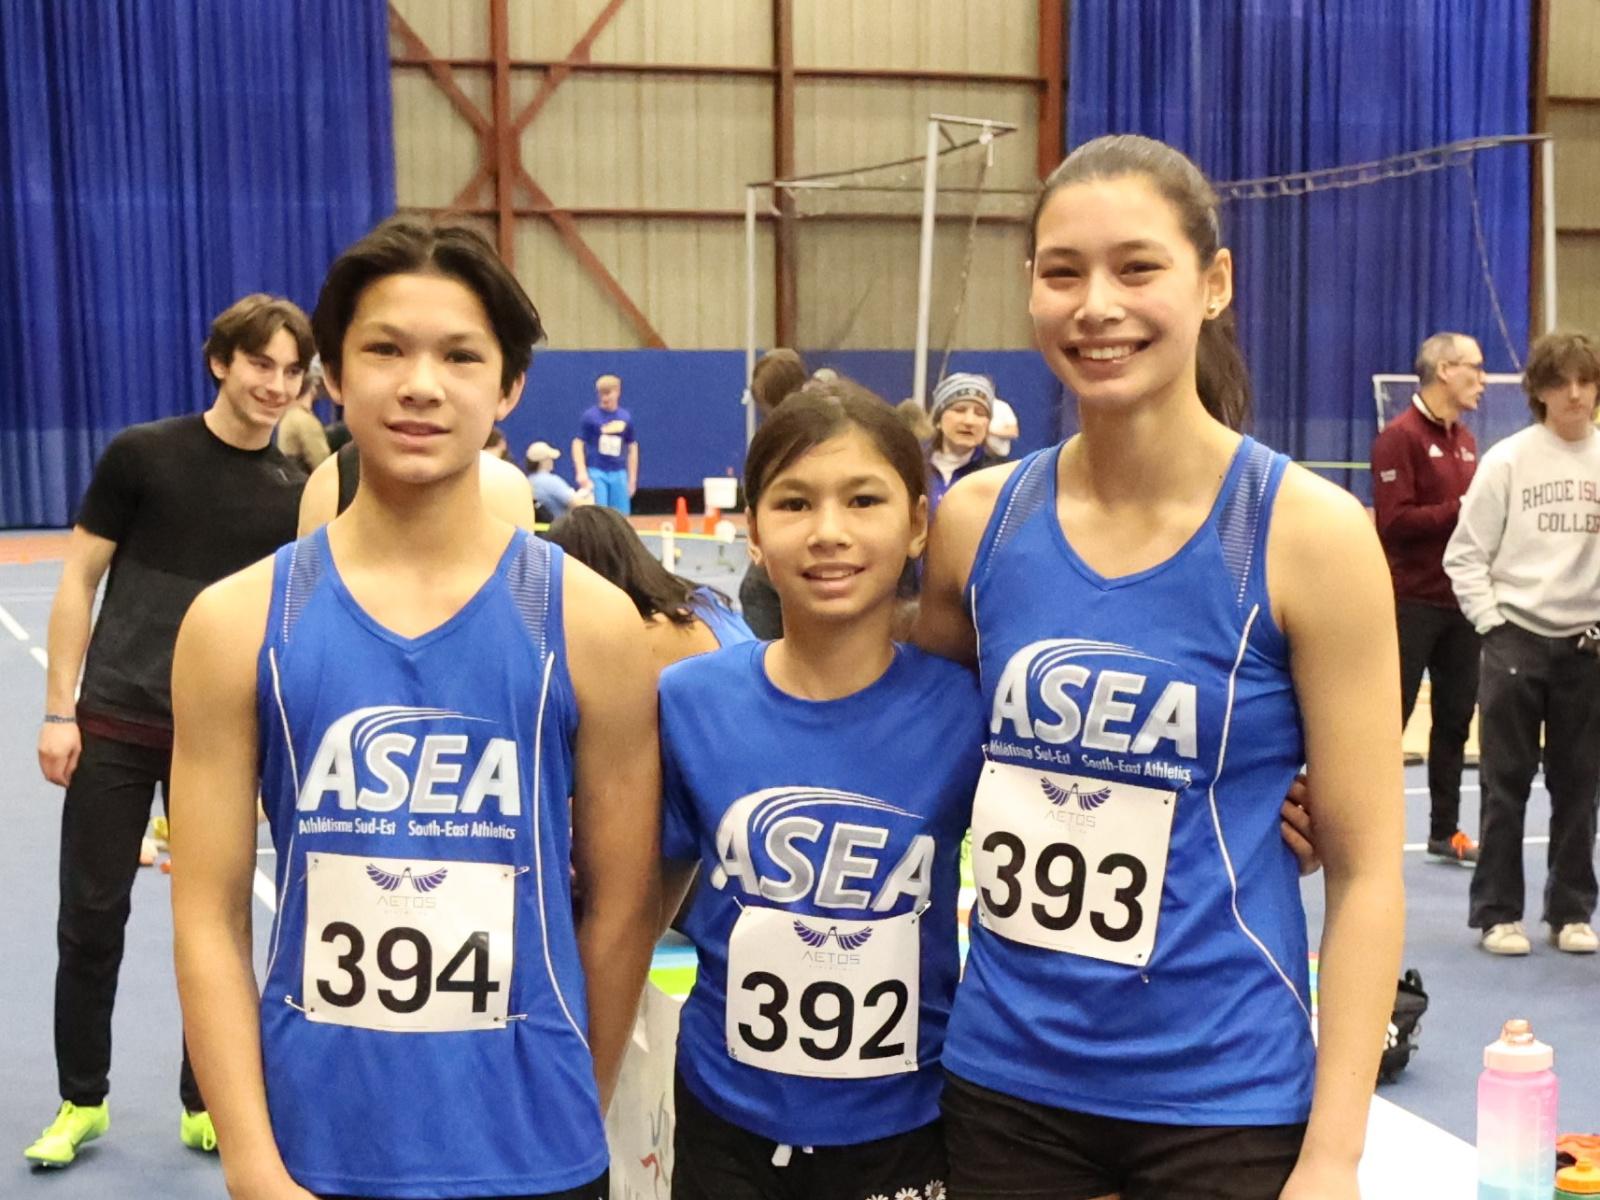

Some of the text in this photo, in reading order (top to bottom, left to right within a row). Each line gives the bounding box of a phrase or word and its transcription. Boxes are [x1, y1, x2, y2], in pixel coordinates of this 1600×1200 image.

[1522, 479, 1574, 512] RHODE
[990, 638, 1198, 759] ASEA
[296, 705, 522, 816] ASEA
[1034, 745, 1072, 764] Sud-Est
[1081, 754, 1192, 781] South-East Athletics
[298, 816, 397, 836] Athlétisme Sud-Est
[407, 820, 517, 840] South-East Athletics
[710, 785, 936, 912] ASEA
[980, 830, 1148, 943] 393
[315, 920, 501, 1014] 394
[800, 950, 861, 965] AETOS
[737, 970, 909, 1062] 392
